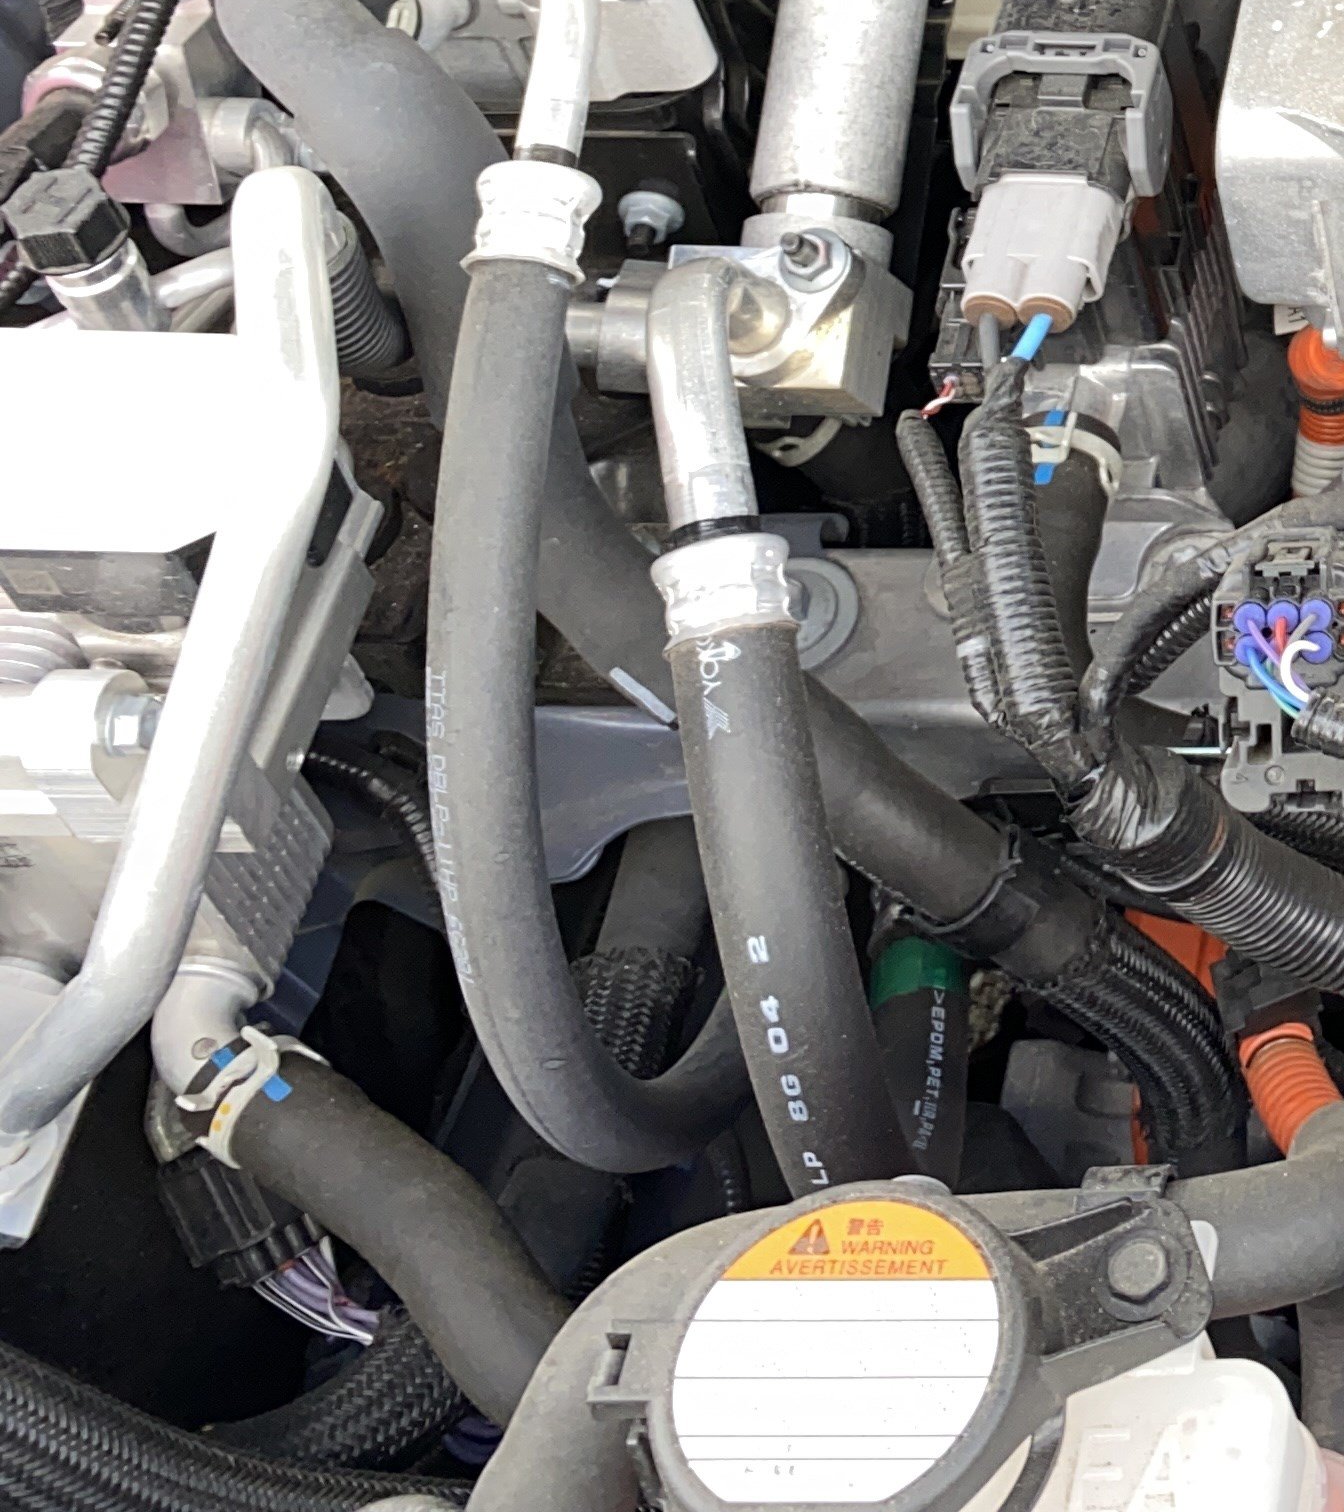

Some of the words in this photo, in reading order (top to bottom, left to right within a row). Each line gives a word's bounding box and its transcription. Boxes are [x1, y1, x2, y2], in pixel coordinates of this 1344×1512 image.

[746, 934, 770, 964] 2
[780, 1073, 810, 1123] 8G
[801, 1150, 830, 1185] LP
[841, 1240, 936, 1256] WARNING
[769, 1259, 949, 1275] AVERTISSEMENT
